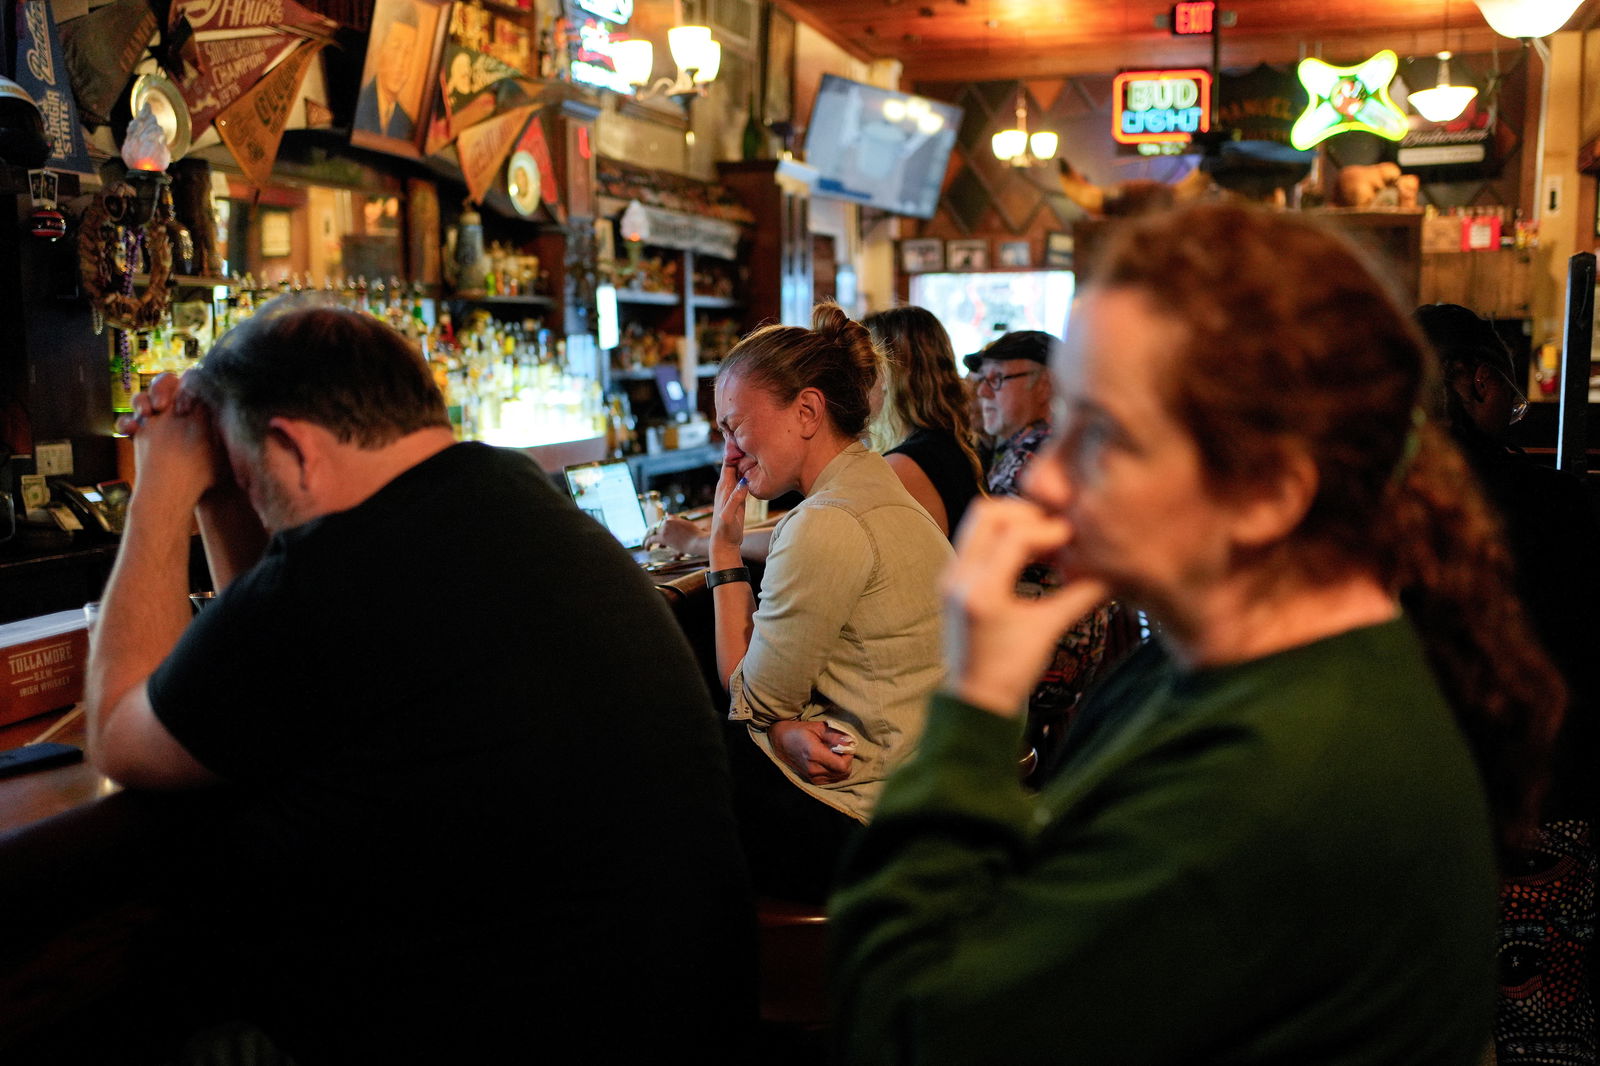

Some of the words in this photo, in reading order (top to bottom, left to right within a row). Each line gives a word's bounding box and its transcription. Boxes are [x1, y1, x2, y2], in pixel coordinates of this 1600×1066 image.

[1127, 79, 1198, 113] BUD
[60, 101, 74, 155] STATE
[1121, 107, 1202, 134] LIGHT
[8, 645, 73, 675] TULLAMORE
[20, 684, 40, 697] IRISH
